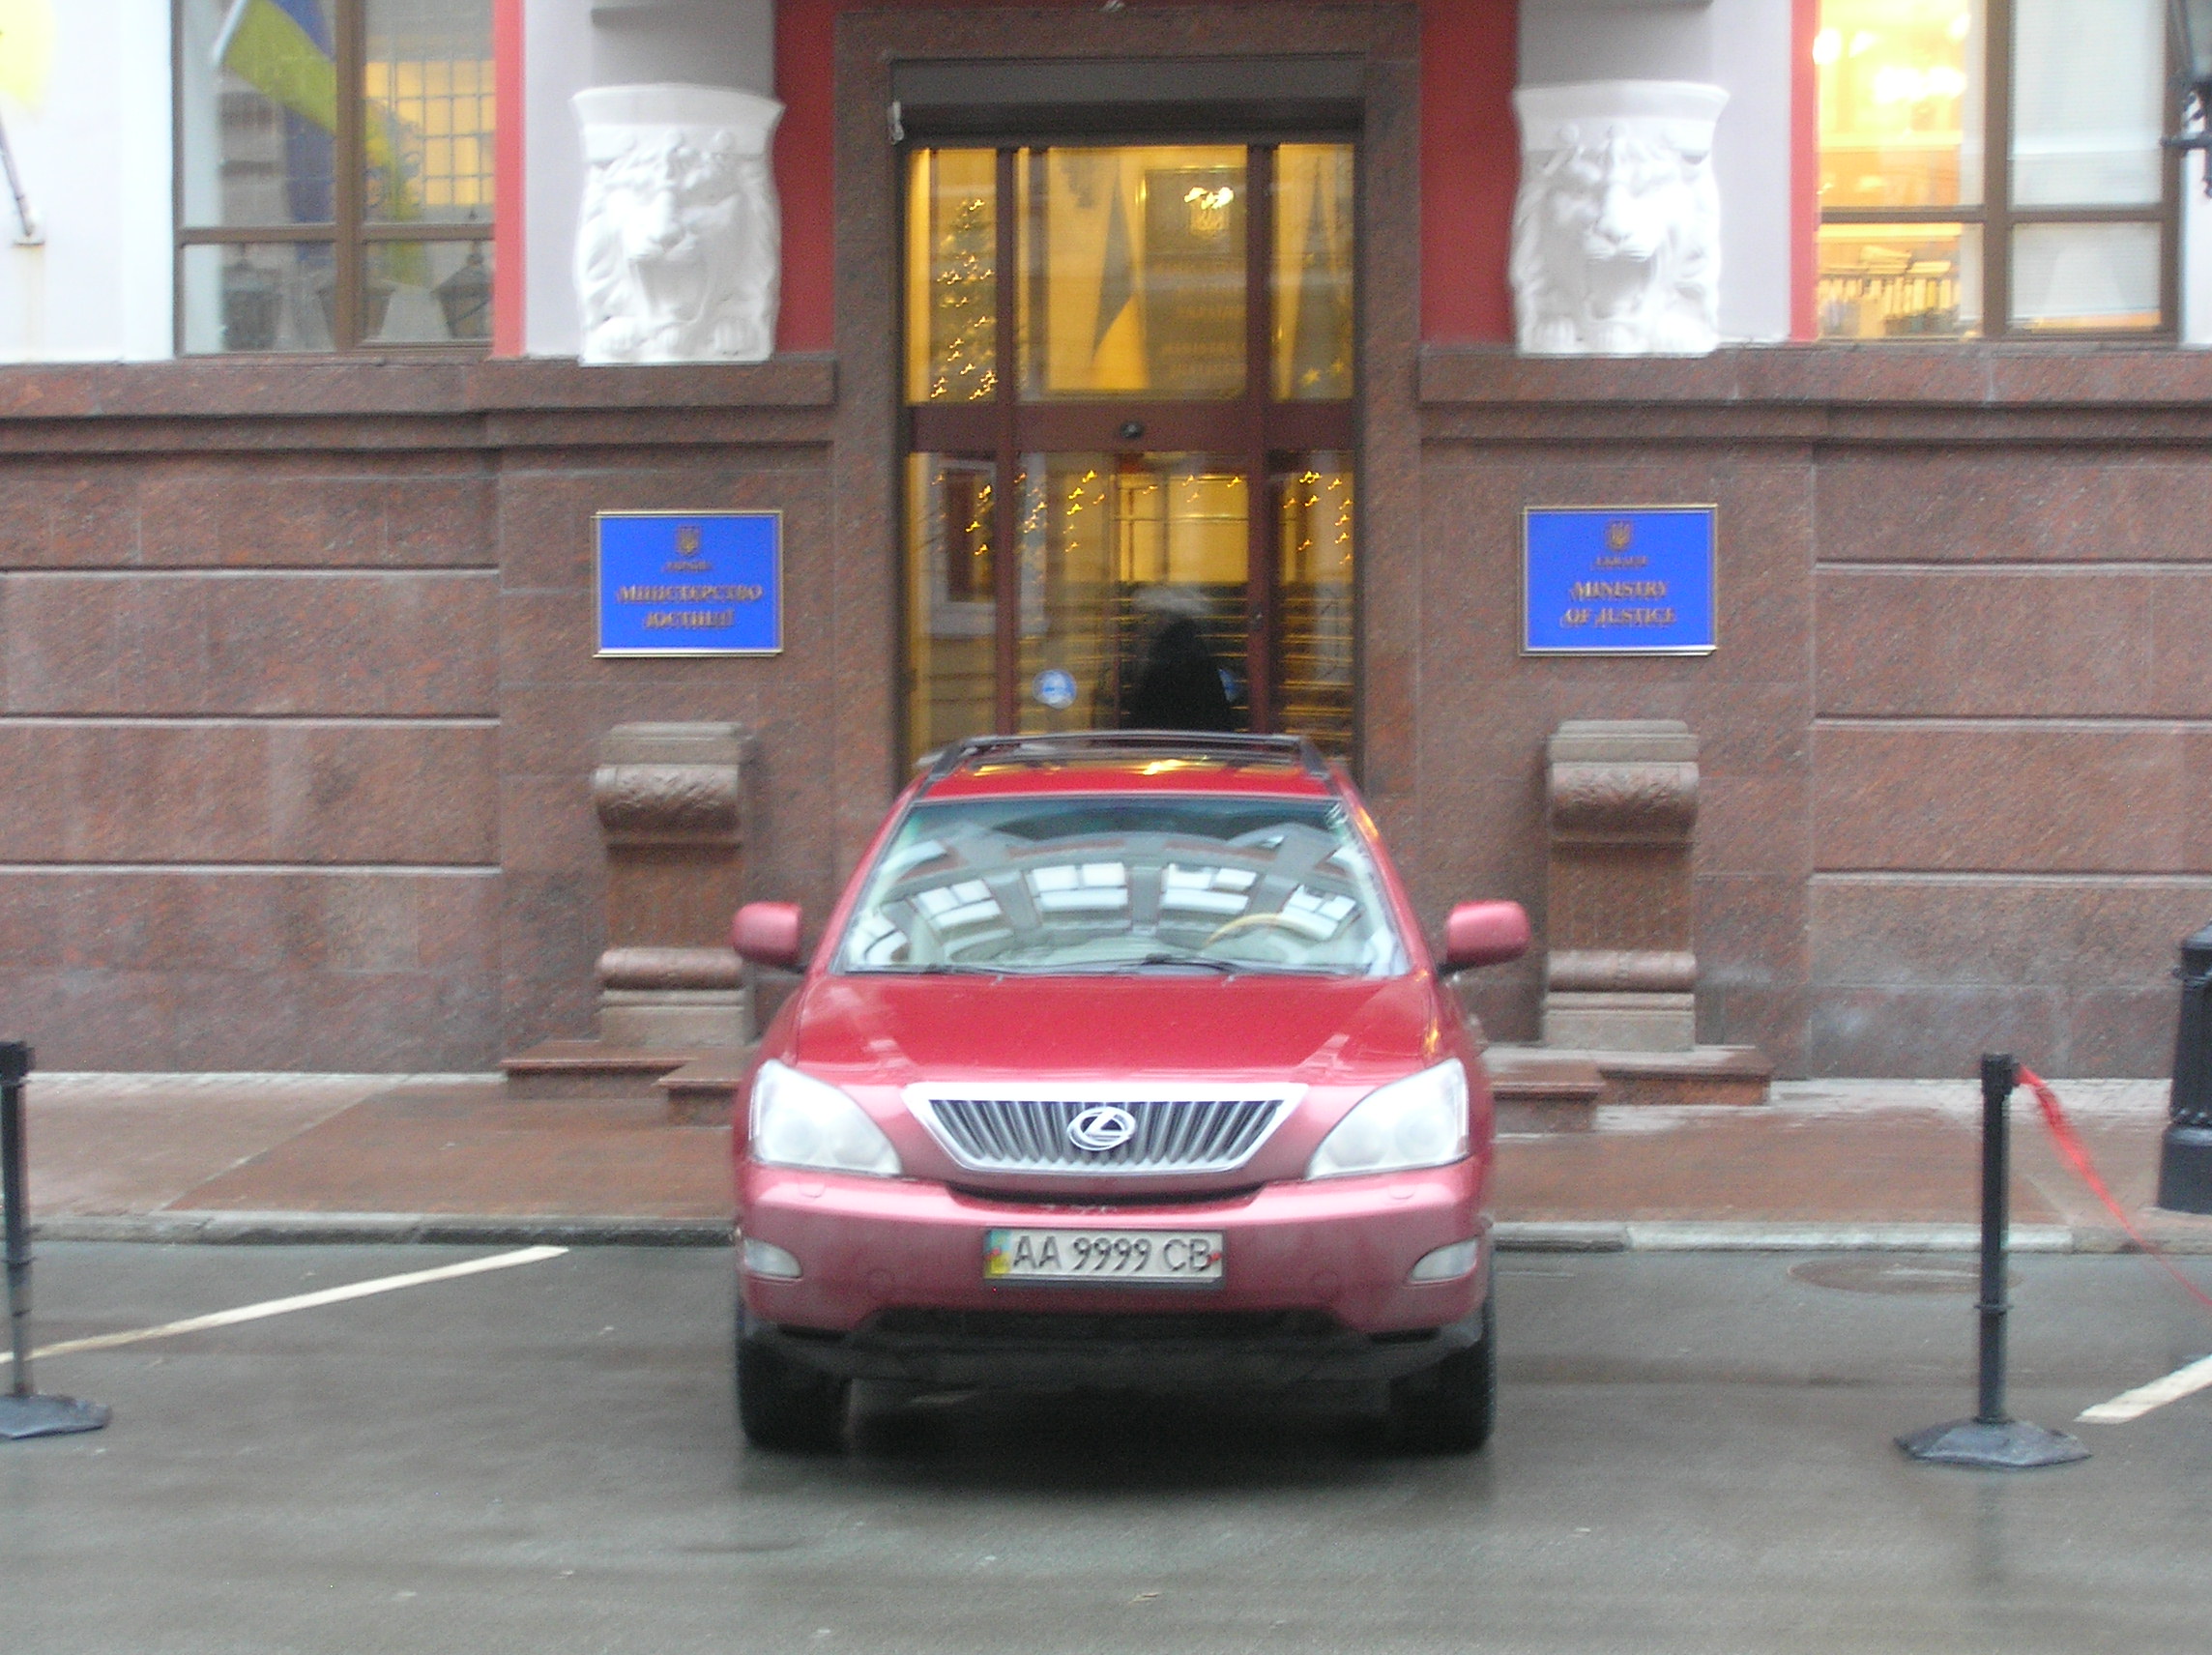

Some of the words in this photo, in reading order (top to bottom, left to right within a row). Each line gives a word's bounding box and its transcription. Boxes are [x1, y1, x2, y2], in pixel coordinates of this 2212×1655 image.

[1572, 582, 1667, 598] MINISTRY
[1562, 609, 1591, 625] OF
[1596, 608, 1676, 625] JUSTICE
[1013, 1235, 1062, 1268] AA
[1071, 1237, 1151, 1272] 9999
[1164, 1238, 1210, 1272] CB
